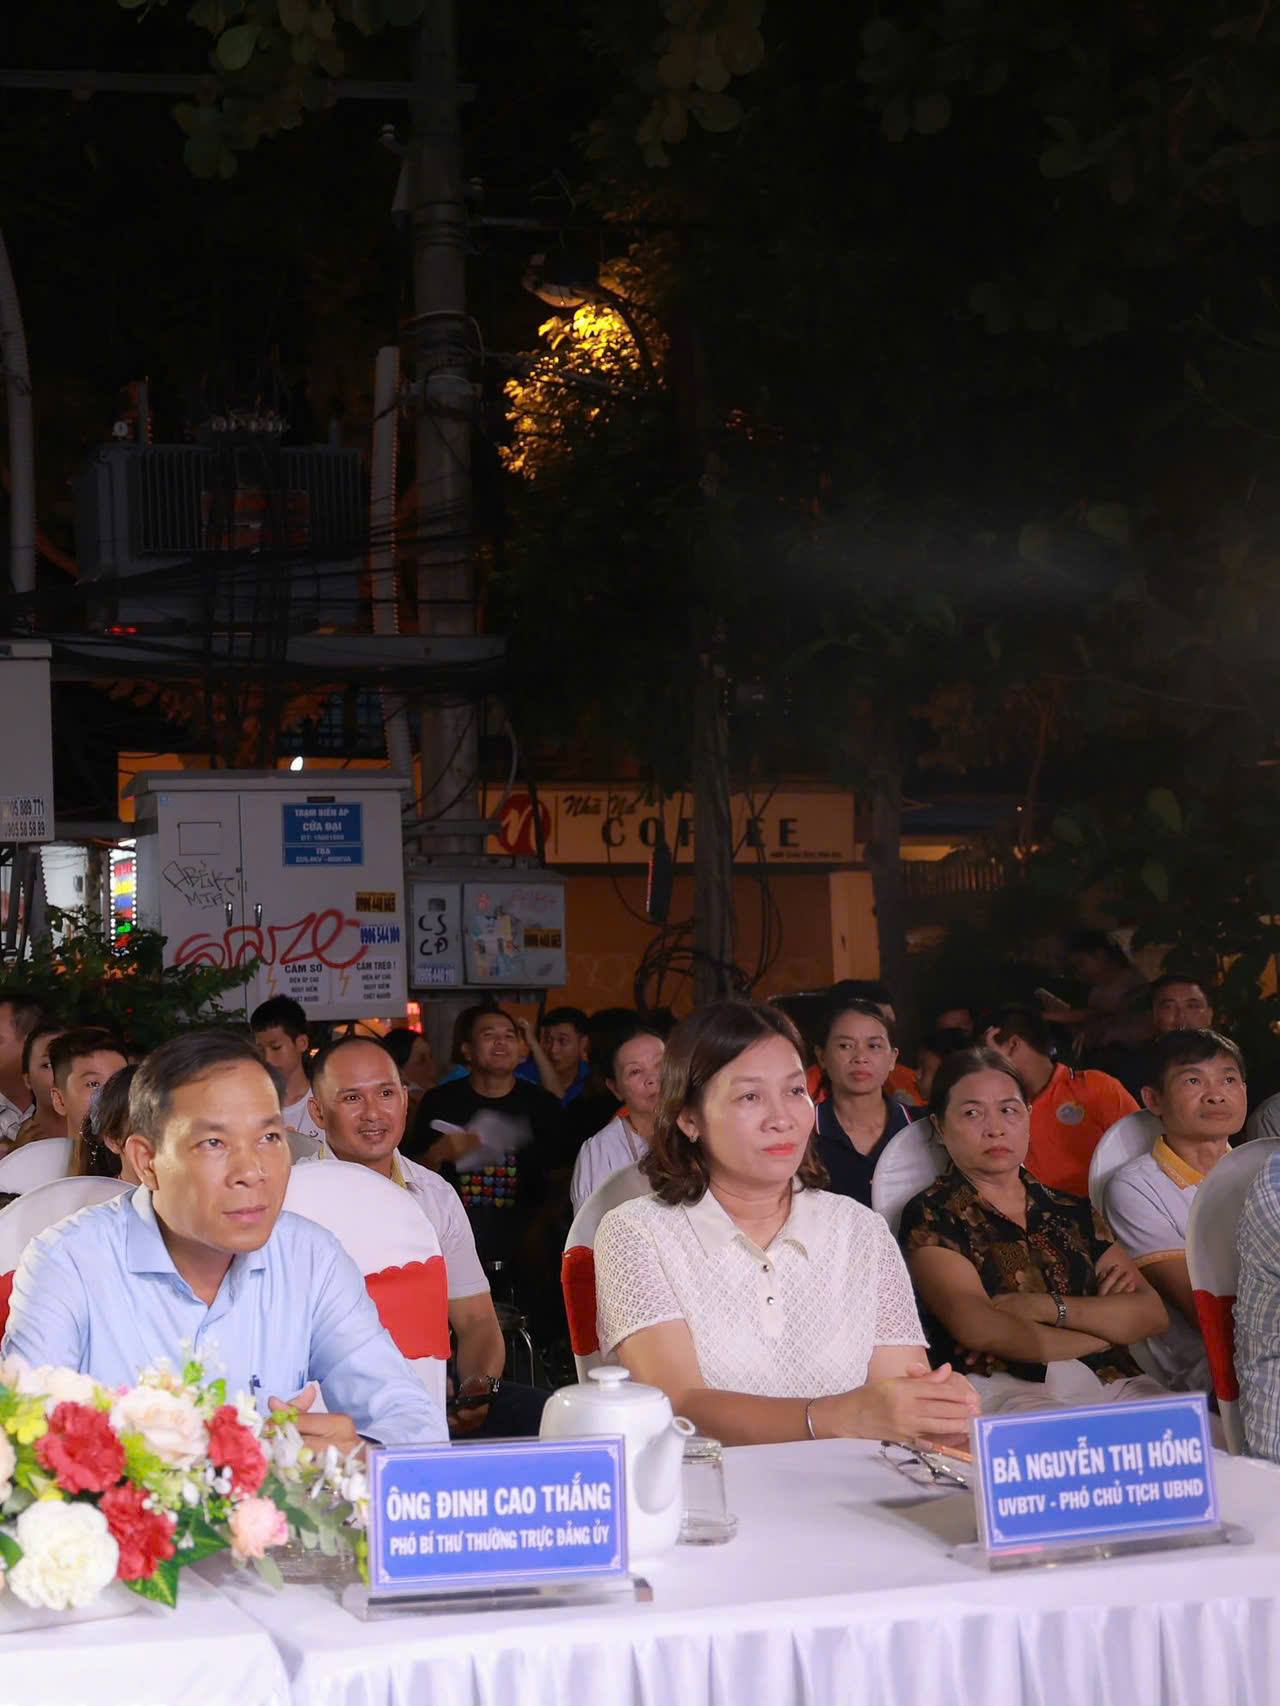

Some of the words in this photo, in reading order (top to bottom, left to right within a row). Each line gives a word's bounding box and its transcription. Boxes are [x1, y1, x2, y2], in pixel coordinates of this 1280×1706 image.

[601, 817, 800, 847] COFEE
[418, 914, 447, 936] CS
[992, 1448, 1022, 1485] BÀ
[1026, 1435, 1106, 1481] NGUYỄN
[1108, 1443, 1144, 1476] THỊ
[1148, 1428, 1204, 1468] HỒNG
[386, 1486, 431, 1521] ÔNG
[436, 1487, 488, 1519] ĐINH
[494, 1486, 537, 1516] CAO
[541, 1471, 612, 1513] THẮNG
[998, 1494, 1046, 1517] UVBTV
[1059, 1486, 1090, 1511] PHÓ
[1093, 1480, 1123, 1508] CHỦ
[1126, 1481, 1159, 1507] TỊCH
[1163, 1478, 1204, 1500] UBND
[390, 1531, 417, 1556] PHÓ
[419, 1530, 435, 1555] BÍ
[437, 1530, 464, 1553] THƯ
[466, 1526, 518, 1553] THƯỜNG
[519, 1524, 554, 1552] TRỰC
[556, 1520, 591, 1546] ĐẢNG
[593, 1518, 611, 1545] ỦY
